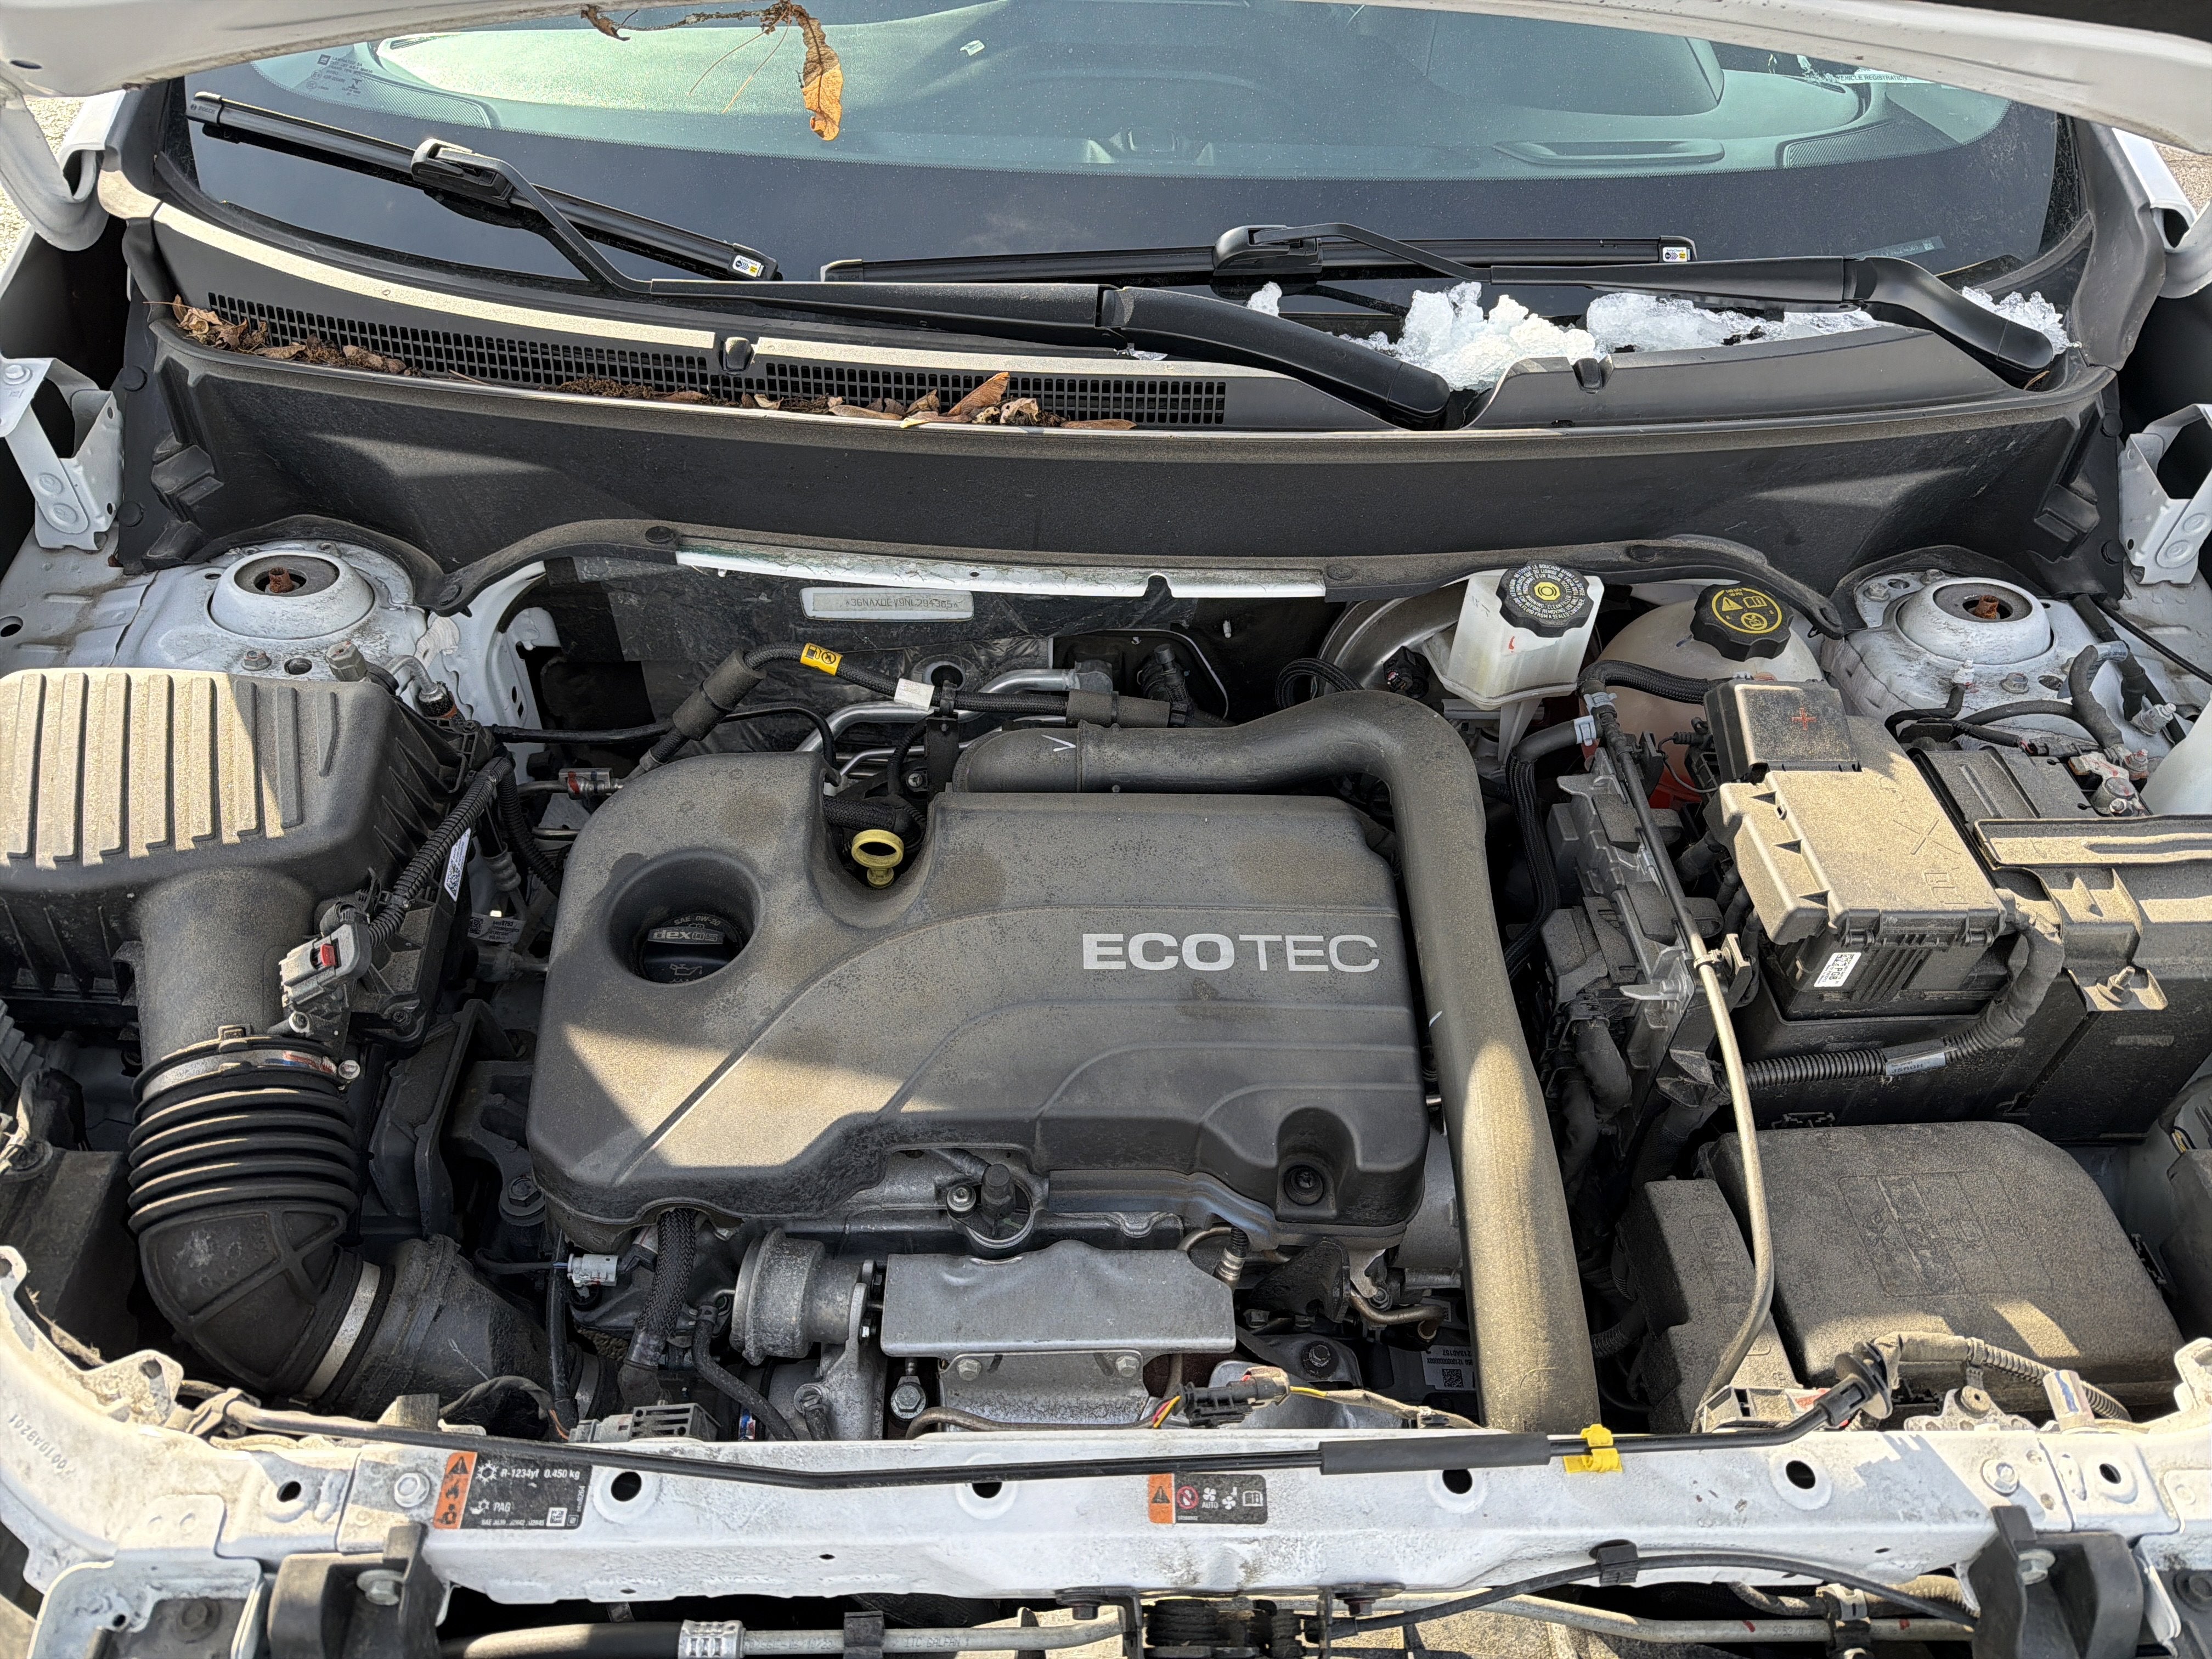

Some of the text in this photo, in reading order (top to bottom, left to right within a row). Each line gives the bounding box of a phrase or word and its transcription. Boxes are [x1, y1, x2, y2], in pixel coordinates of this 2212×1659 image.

[1538, 563, 1561, 572] BOUCHON
[1534, 611, 1548, 619] FROM
[674, 915, 721, 926] SAE 0W-20
[652, 929, 718, 942] dexos
[1082, 933, 1380, 972] ECOTEC
[543, 1469, 567, 1479] 0.450
[568, 1469, 581, 1480] kg
[494, 1502, 511, 1512] PAG
